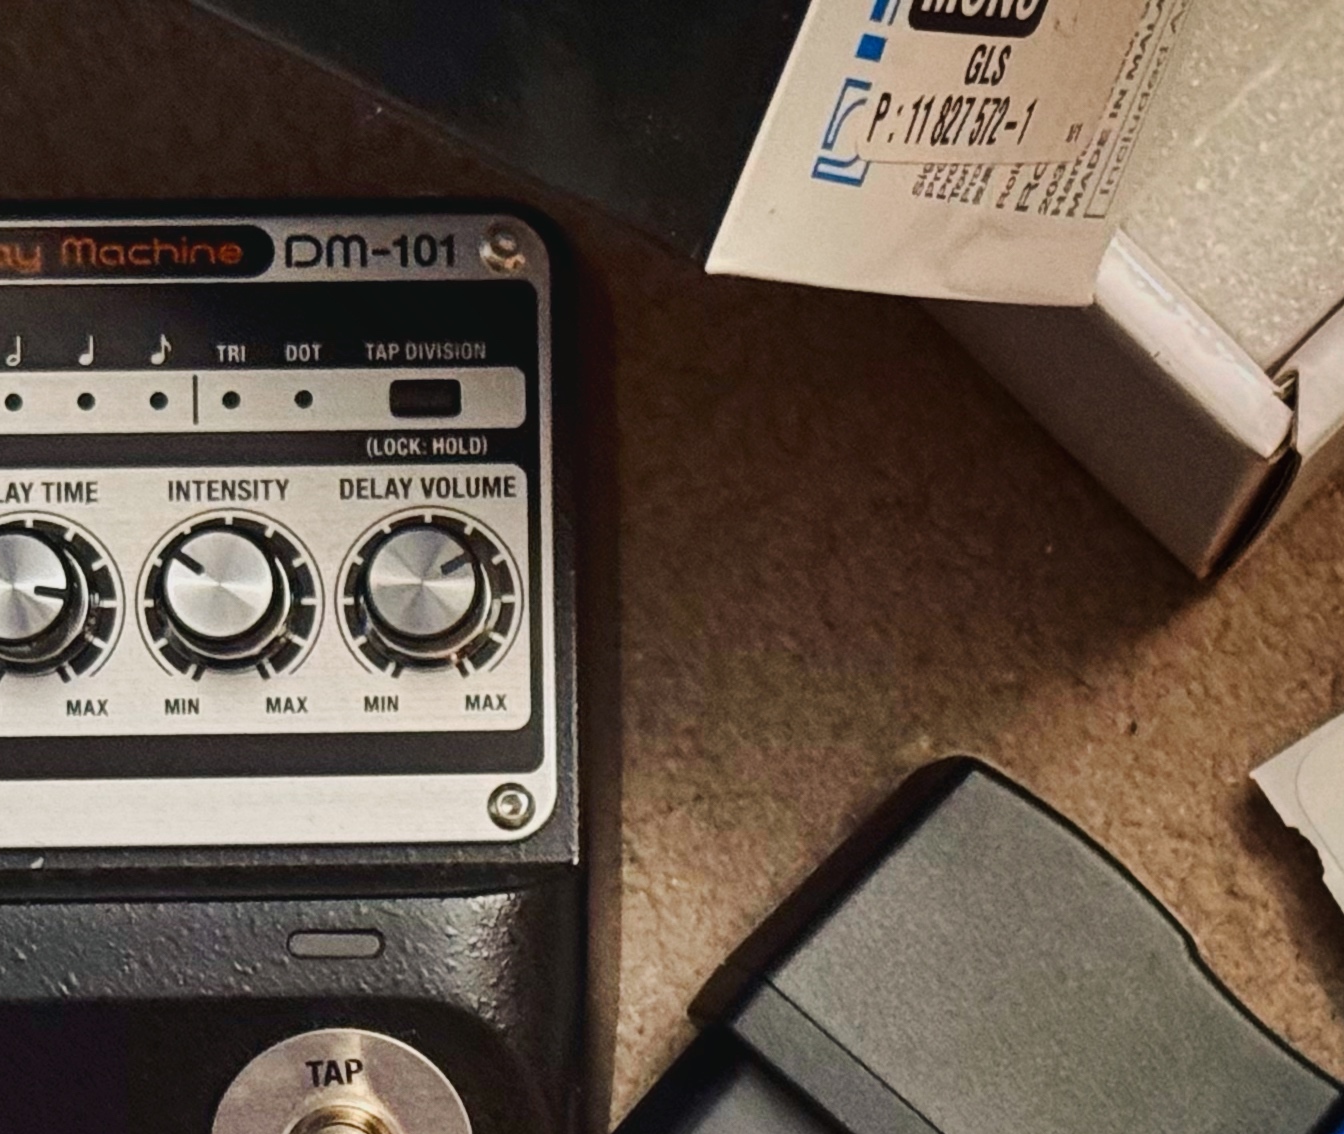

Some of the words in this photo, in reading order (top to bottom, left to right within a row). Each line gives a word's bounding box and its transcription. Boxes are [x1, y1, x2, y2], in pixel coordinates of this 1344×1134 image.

[964, 44, 1012, 87] GLS
[930, 95, 976, 147] 827
[1100, 46, 1169, 195] Included
[1066, 129, 1109, 218] MADE
[1109, 88, 1129, 119] IN
[60, 236, 245, 269] Machine
[284, 235, 458, 269] DM-101
[217, 343, 247, 363] TRI
[285, 343, 321, 363] DOT
[365, 341, 399, 361] TAP
[404, 340, 486, 361] DIVISION
[365, 436, 427, 458] (LOCK:
[431, 435, 489, 456] HOLD)
[40, 481, 99, 503] TIME
[167, 479, 290, 502] INTENSITY
[339, 477, 415, 500] DELAY
[420, 476, 517, 499] VOLUME
[66, 699, 109, 717] MAX
[164, 698, 200, 716] MIN
[265, 697, 308, 715] MAX
[363, 696, 399, 714] MIN
[464, 695, 508, 713] MAX
[306, 1056, 365, 1092] TAP
